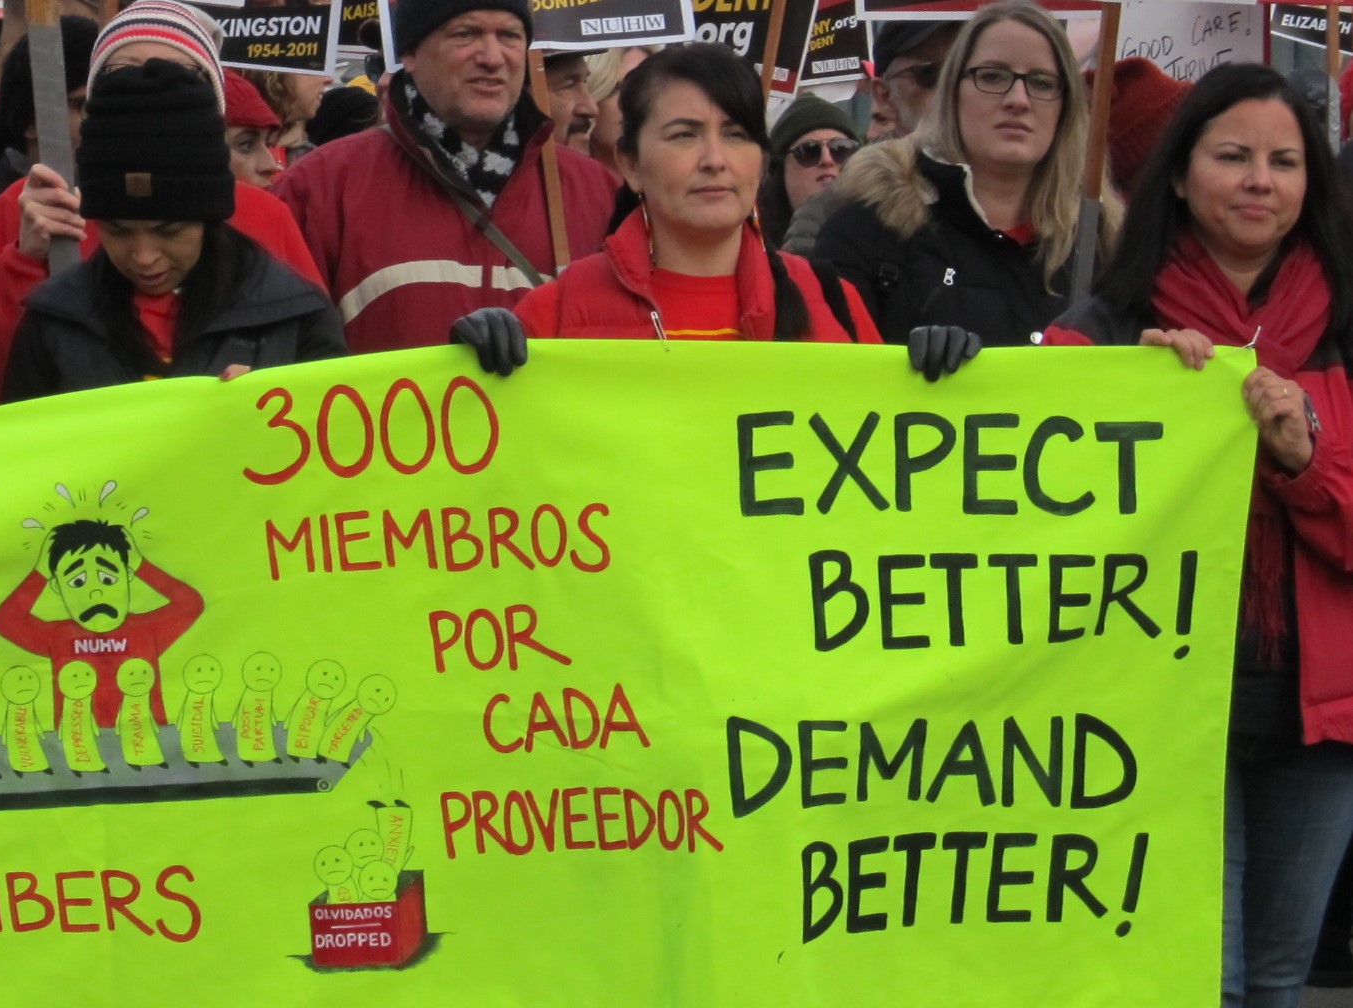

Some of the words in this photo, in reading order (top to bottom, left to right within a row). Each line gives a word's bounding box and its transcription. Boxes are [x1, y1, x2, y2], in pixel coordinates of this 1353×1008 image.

[247, 42, 318, 58] 1954-2011
[581, 14, 665, 35] NUHW
[697, 22, 754, 56] org
[812, 57, 860, 74] NUHW
[243, 376, 499, 485] 3000
[737, 410, 1163, 517] EXPECT
[266, 502, 610, 581] MIEMBROS
[808, 549, 1198, 660] BETTER!
[74, 639, 127, 653] NUHW
[429, 604, 572, 673] POR
[69, 698, 91, 763] DEPRESSED
[129, 703, 145, 756] TRAUMA
[192, 697, 205, 753] SUICIDAL
[252, 698, 264, 751] PARTUM
[295, 697, 321, 749] BIPOLAR
[483, 683, 650, 752] CADA
[727, 712, 1138, 818] DEMAND
[440, 786, 724, 859] PROVEEDOR
[315, 906, 392, 920] OLVIDADOS
[801, 832, 1148, 944] BETTER!
[315, 932, 391, 948] DROPPED
